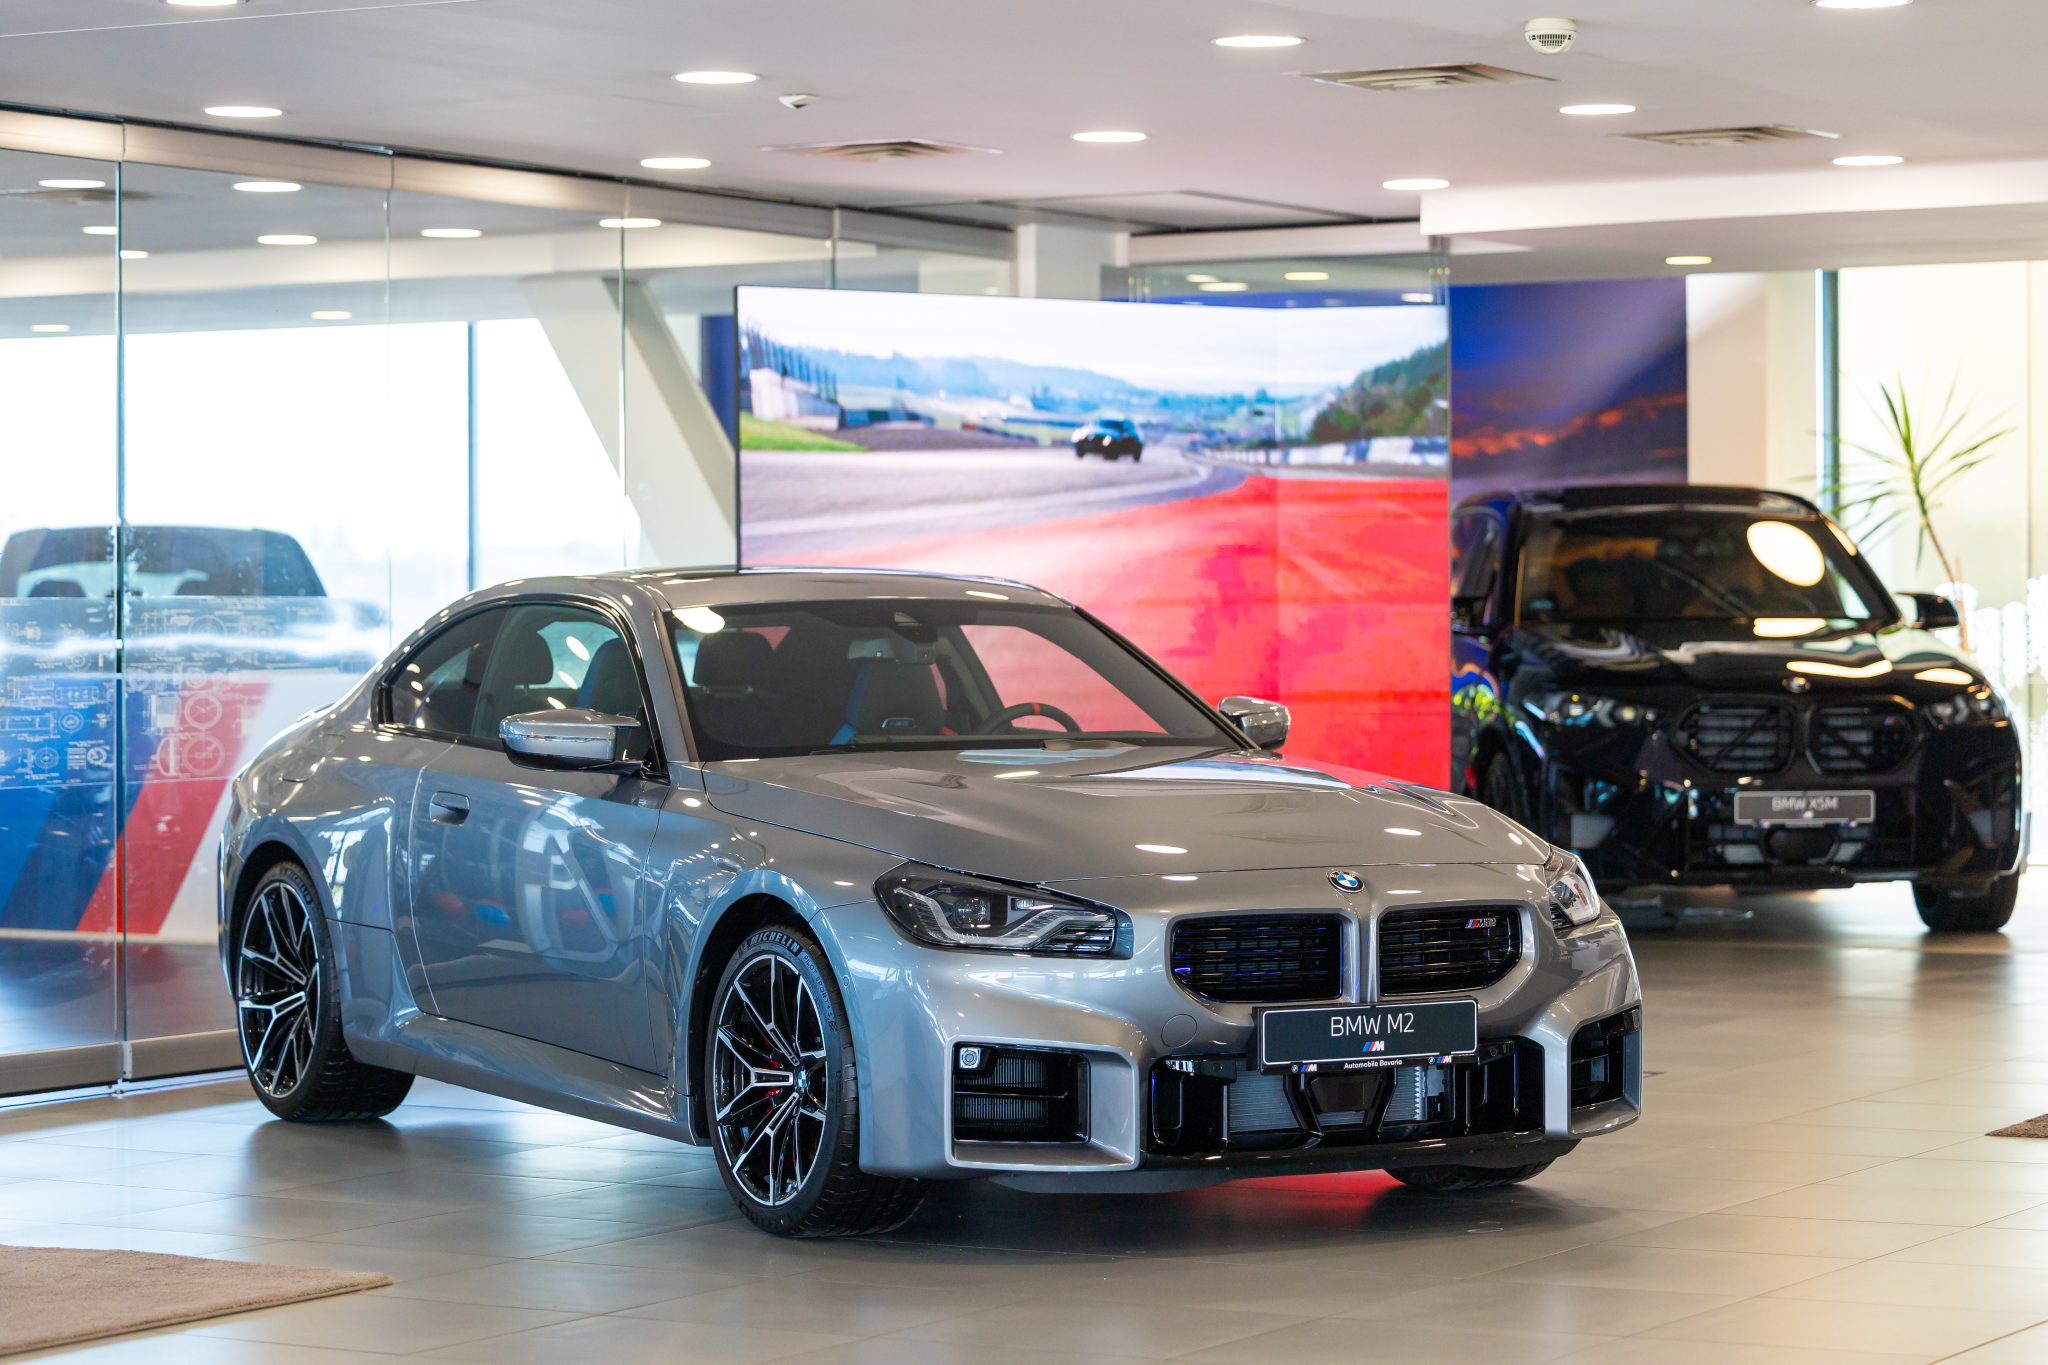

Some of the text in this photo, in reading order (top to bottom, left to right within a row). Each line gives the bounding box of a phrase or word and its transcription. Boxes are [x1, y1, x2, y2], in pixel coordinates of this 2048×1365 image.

[1772, 796, 1839, 811] BMW X5M
[750, 931, 801, 953] MICHELIN
[803, 954, 829, 1003] PILOT SPORT
[1330, 1012, 1415, 1037] BMW M2
[1343, 1058, 1403, 1070] Automobile Bavaria
